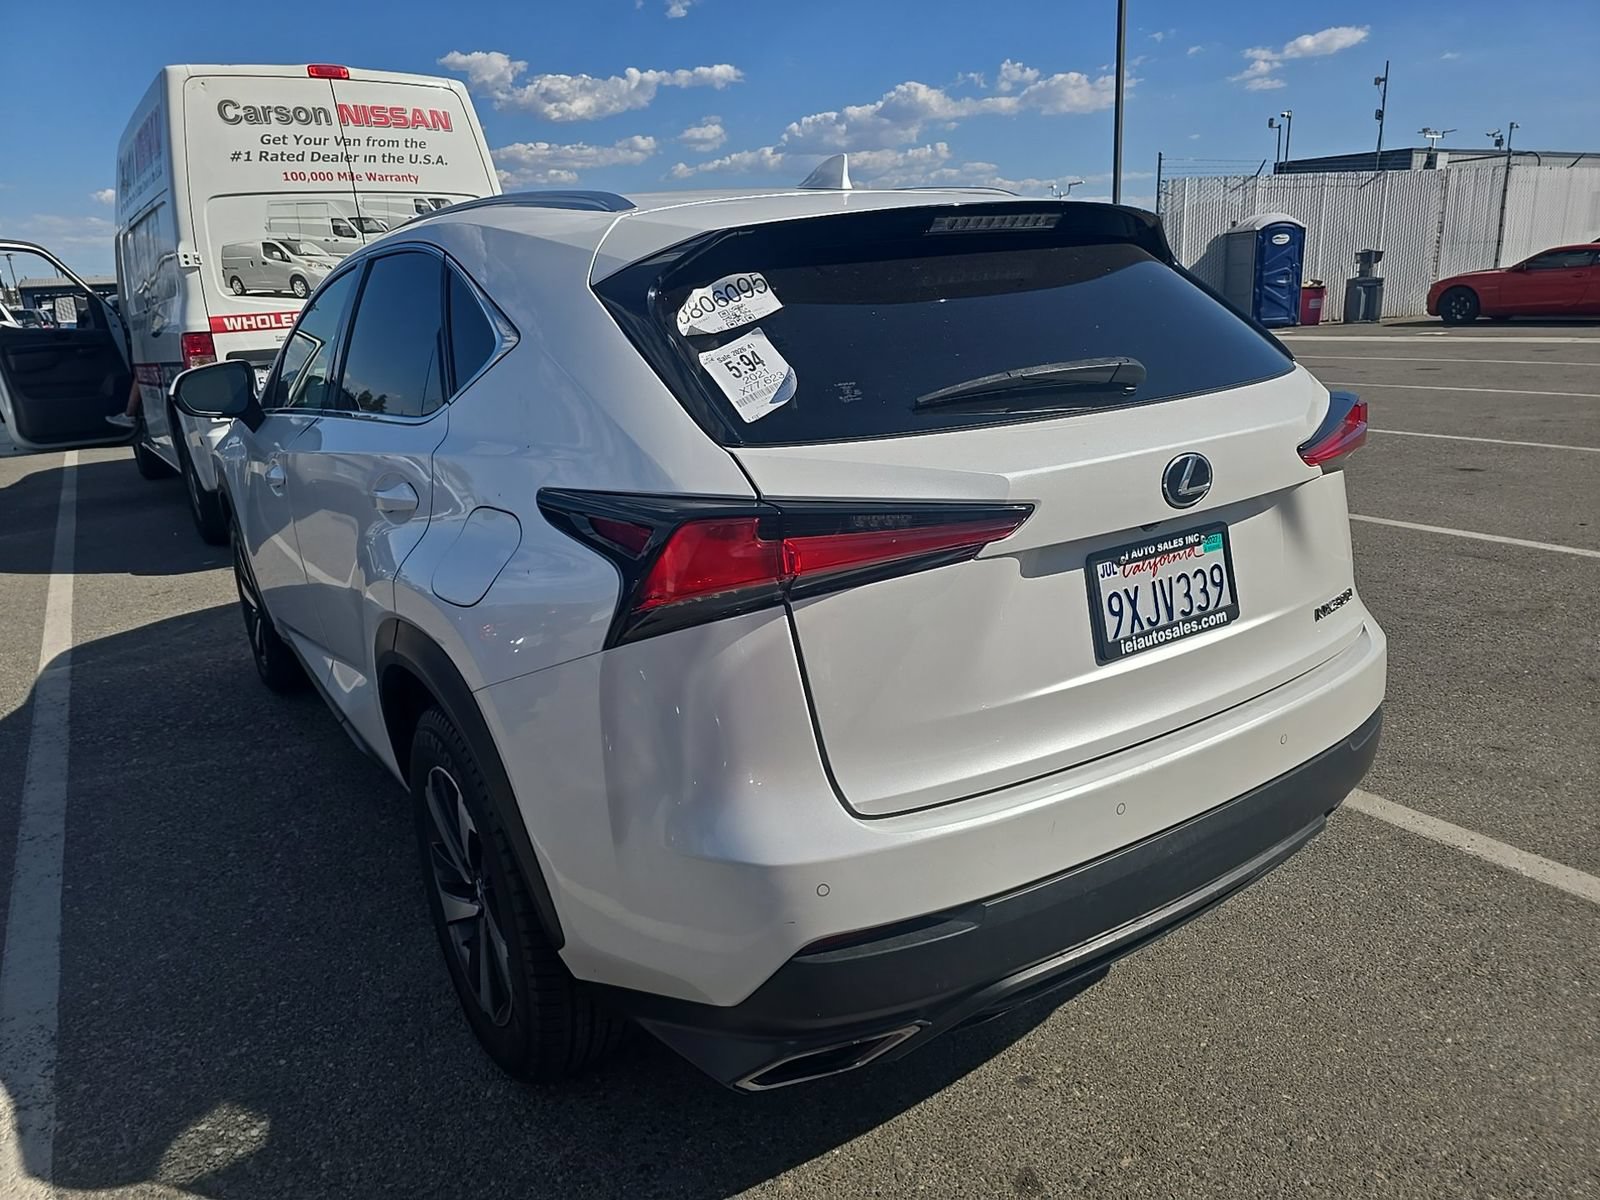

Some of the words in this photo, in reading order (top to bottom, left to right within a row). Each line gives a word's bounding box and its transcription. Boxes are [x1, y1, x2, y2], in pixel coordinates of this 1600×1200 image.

[217, 99, 333, 126] Carson
[337, 103, 454, 133] NISSAN
[260, 134, 288, 145] Get
[293, 134, 329, 146] Your
[334, 135, 361, 147] Van
[366, 136, 399, 148] from
[404, 138, 426, 149] the
[230, 150, 252, 162] #1
[258, 151, 305, 162] Rated
[310, 151, 359, 163] Dealer
[363, 153, 376, 163] in
[381, 152, 404, 164] the
[408, 154, 448, 166] U.S.A.
[283, 171, 333, 183] 100,000
[337, 172, 362, 182] Mile
[365, 172, 419, 185] Warranty
[724, 350, 766, 379] 5:94
[742, 367, 770, 385] 2021
[1131, 545, 1156, 559] AUTO
[1156, 537, 1184, 552] SALES
[1185, 533, 1200, 545] INC
[1100, 561, 1118, 579] JUL
[1107, 563, 1224, 639] 9XJV339
[1120, 610, 1228, 655] ieiautosales.com
